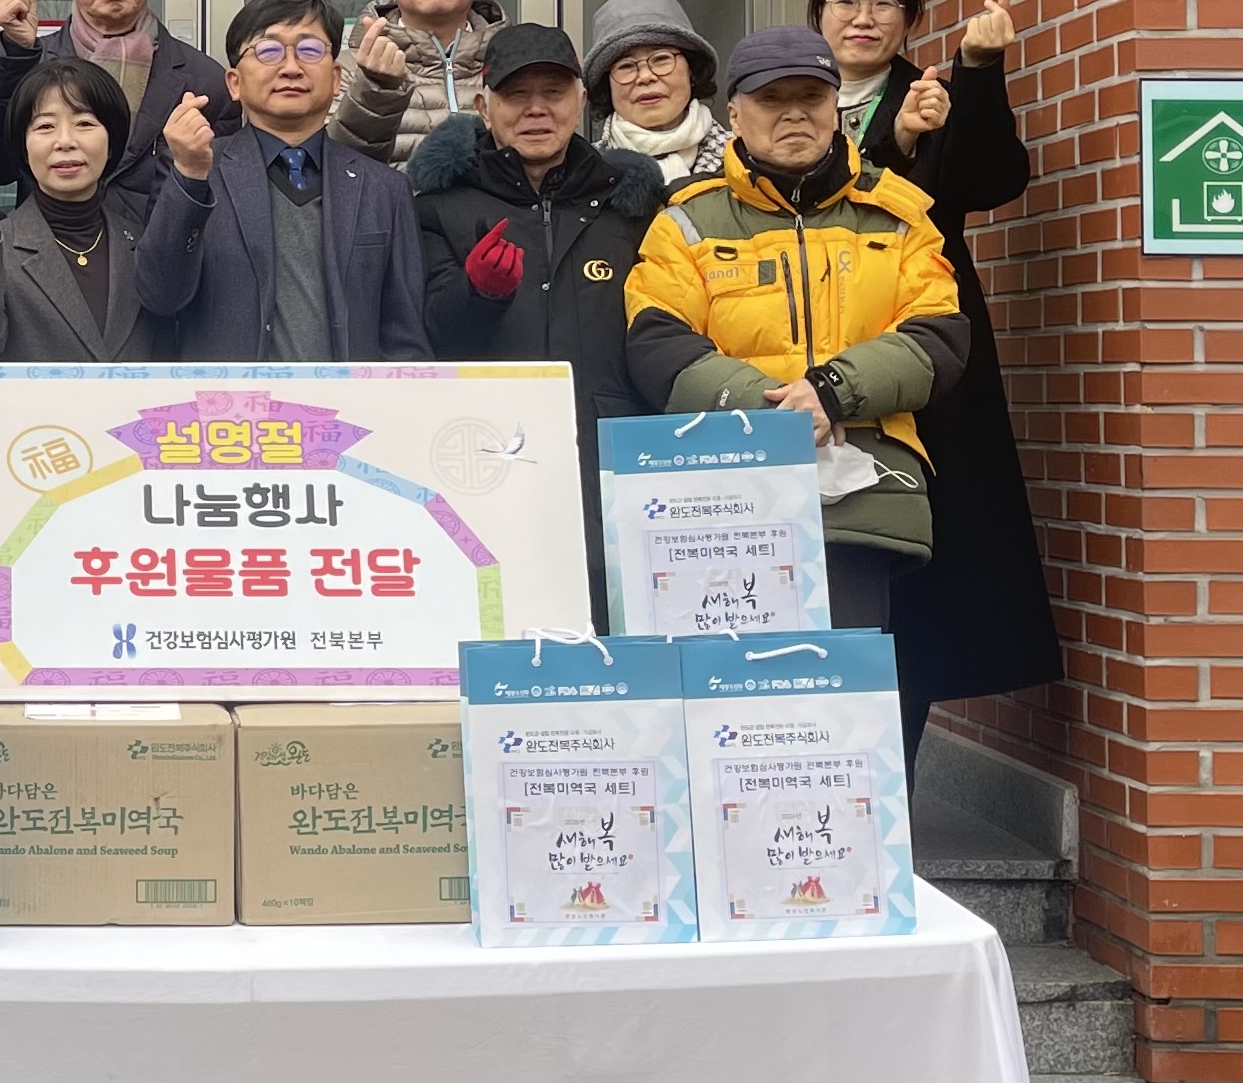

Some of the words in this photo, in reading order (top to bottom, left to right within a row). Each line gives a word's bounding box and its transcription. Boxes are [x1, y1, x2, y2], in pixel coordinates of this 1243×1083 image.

[157, 420, 304, 465] 설명절
[21, 438, 81, 480] 福
[143, 482, 344, 528] 나눔행사
[670, 502, 754, 518] 완도전복주식회사
[669, 546, 738, 562] [전복미역국
[745, 544, 775, 557] 세트]
[70, 547, 291, 597] 후원물품
[309, 548, 421, 597] 전달
[702, 592, 739, 609] 새해
[741, 572, 757, 610] 복
[695, 613, 721, 631] 많이
[725, 611, 770, 630] 받으세요
[145, 630, 296, 650] 건강보험심사평가원
[310, 631, 384, 650] 전북본부
[526, 738, 615, 753] 완도전복주식회사
[741, 730, 829, 747] 완도전복주식회사
[291, 783, 359, 800] 바다담은
[524, 781, 597, 797] [전복미역국
[604, 781, 636, 796] 세트]
[740, 775, 812, 792] [전복미역국
[819, 774, 851, 788] 세트]
[557, 832, 596, 849] 새해
[597, 812, 617, 851] 복
[774, 826, 813, 843] 새해
[814, 805, 833, 845] 복
[28, 846, 74, 856] Abalone
[76, 846, 97, 856] and
[100, 846, 148, 856] Seaweed
[150, 846, 179, 858] Soup
[289, 845, 329, 855] Wando
[330, 845, 377, 855] Abalone
[379, 844, 401, 855] and
[402, 843, 451, 854] Seaweed
[453, 843, 468, 854] So
[767, 847, 794, 866] 많이
[798, 847, 846, 866] 받으세요
[548, 852, 576, 871] 많이
[581, 852, 628, 871] 받으세요
